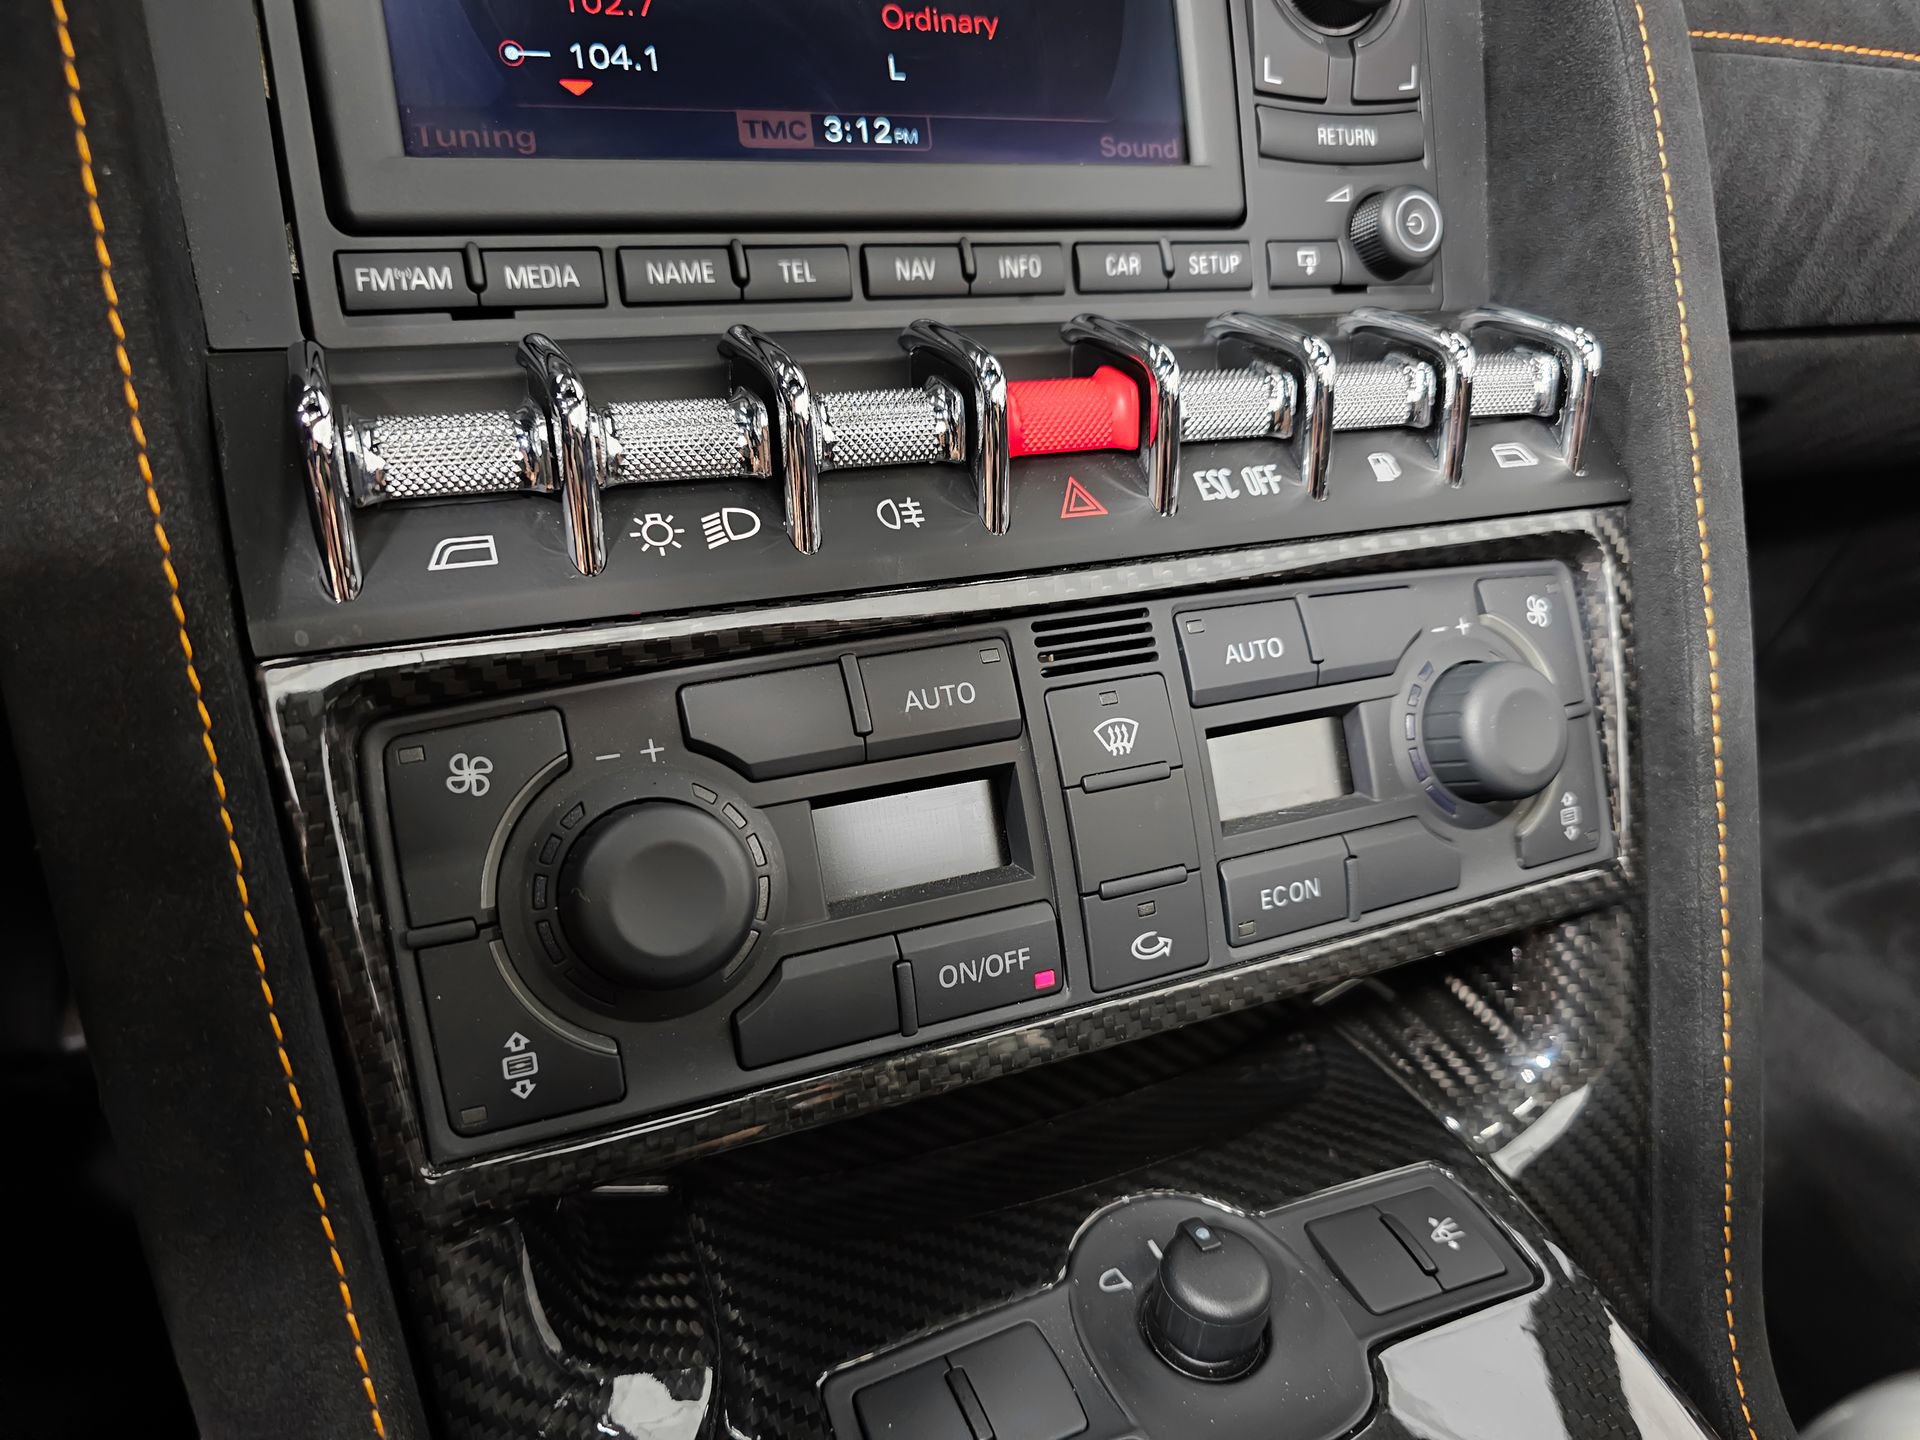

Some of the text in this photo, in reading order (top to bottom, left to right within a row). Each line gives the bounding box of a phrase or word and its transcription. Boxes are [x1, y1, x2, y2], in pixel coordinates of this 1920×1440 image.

[881, 3, 999, 40] Ordinary
[569, 42, 658, 72] 104.1
[416, 124, 536, 155] Tuning
[742, 118, 807, 141] TMC
[1317, 127, 1377, 147] RETURN
[1100, 136, 1178, 160] Sound
[504, 263, 581, 290] MEDIA
[646, 260, 716, 285] NAME
[778, 259, 817, 283] TEL
[894, 257, 936, 282] NAV
[999, 255, 1042, 279] INFO
[1105, 253, 1142, 277] CAR
[1187, 252, 1241, 275] SETUP
[1193, 464, 1282, 501] ESC OFF
[1224, 635, 1286, 666] AUTO
[904, 681, 977, 713] AUTO
[1259, 876, 1322, 912] ECON
[937, 946, 1032, 989] ON/OFF
